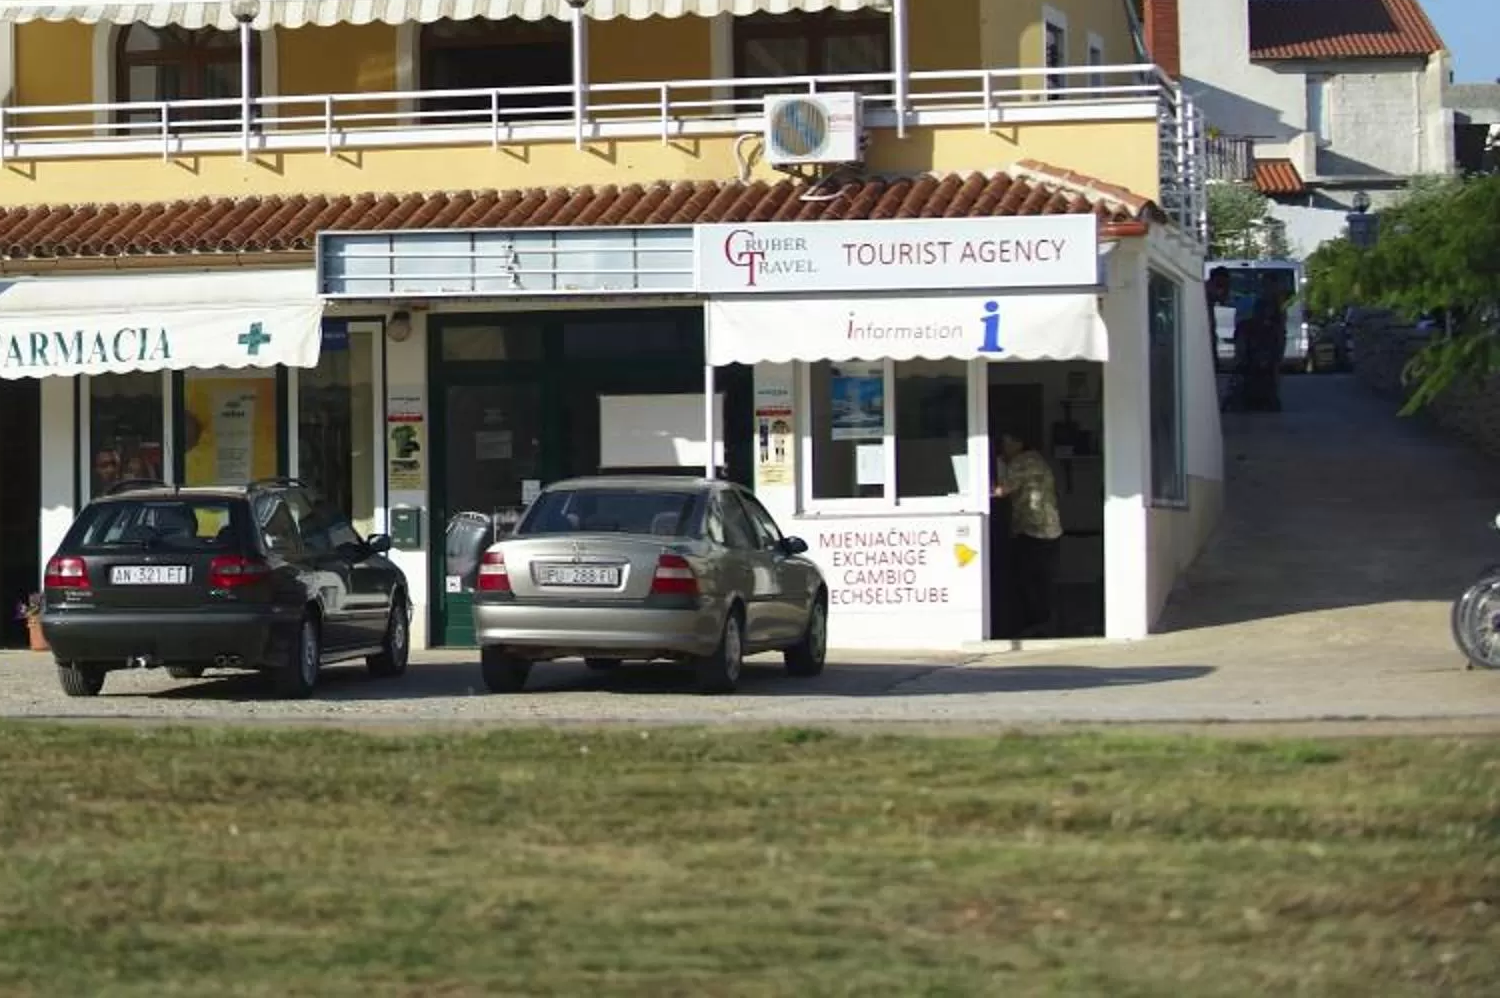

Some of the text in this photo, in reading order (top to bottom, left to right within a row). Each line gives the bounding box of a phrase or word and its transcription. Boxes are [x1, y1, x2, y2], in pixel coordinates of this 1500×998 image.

[724, 229, 808, 267] GRUBER
[841, 239, 1066, 267] TOURIST AGENCY
[737, 250, 818, 287] TRAVEL
[847, 310, 963, 340] information
[819, 528, 941, 549] MJENJAČNICA
[832, 550, 928, 567] EXCHANGE
[843, 569, 917, 585] CAMBIO
[829, 587, 950, 605] ECHSELSTUBE
